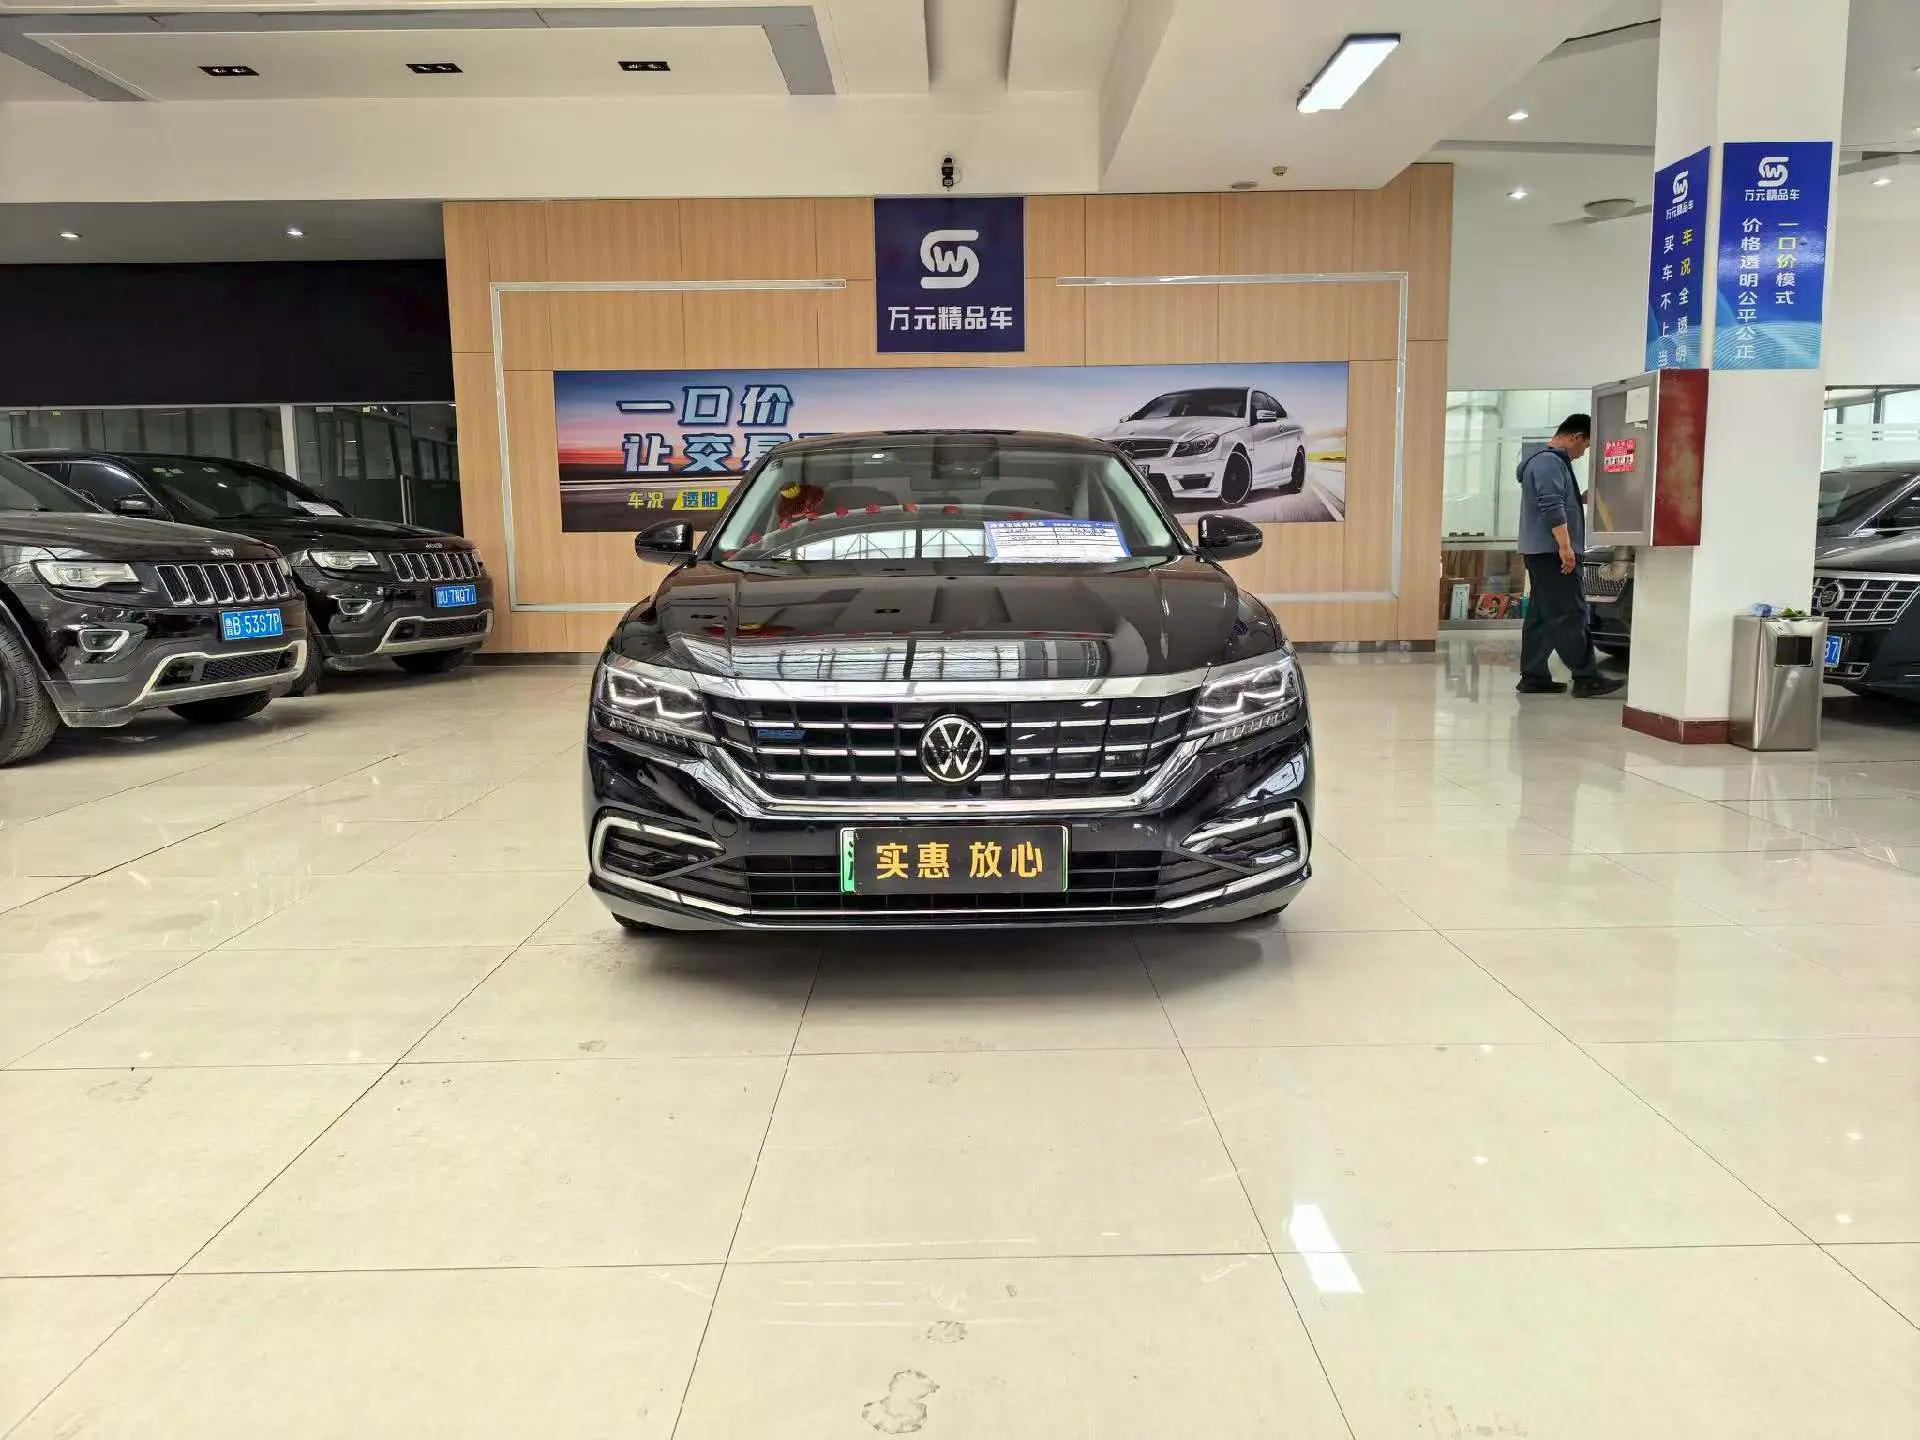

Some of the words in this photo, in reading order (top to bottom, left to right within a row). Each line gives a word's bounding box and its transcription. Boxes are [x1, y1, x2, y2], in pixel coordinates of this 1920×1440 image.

[1665, 199, 1694, 220] 万元精品车
[1744, 188, 1800, 201] 万元精品车
[1775, 221, 1799, 305] 一口价模式
[1657, 234, 1674, 367] 买车不上当
[1675, 229, 1693, 363] 车况全透明
[1735, 217, 1762, 360] 价格透明公平公正
[887, 305, 1013, 331] 万元精品车
[616, 384, 793, 426] 一口价
[622, 432, 843, 473] 让交易
[628, 491, 664, 509] 车况
[683, 491, 718, 508] 透明
[876, 842, 950, 880] 实惠
[968, 840, 1044, 878] 放心
